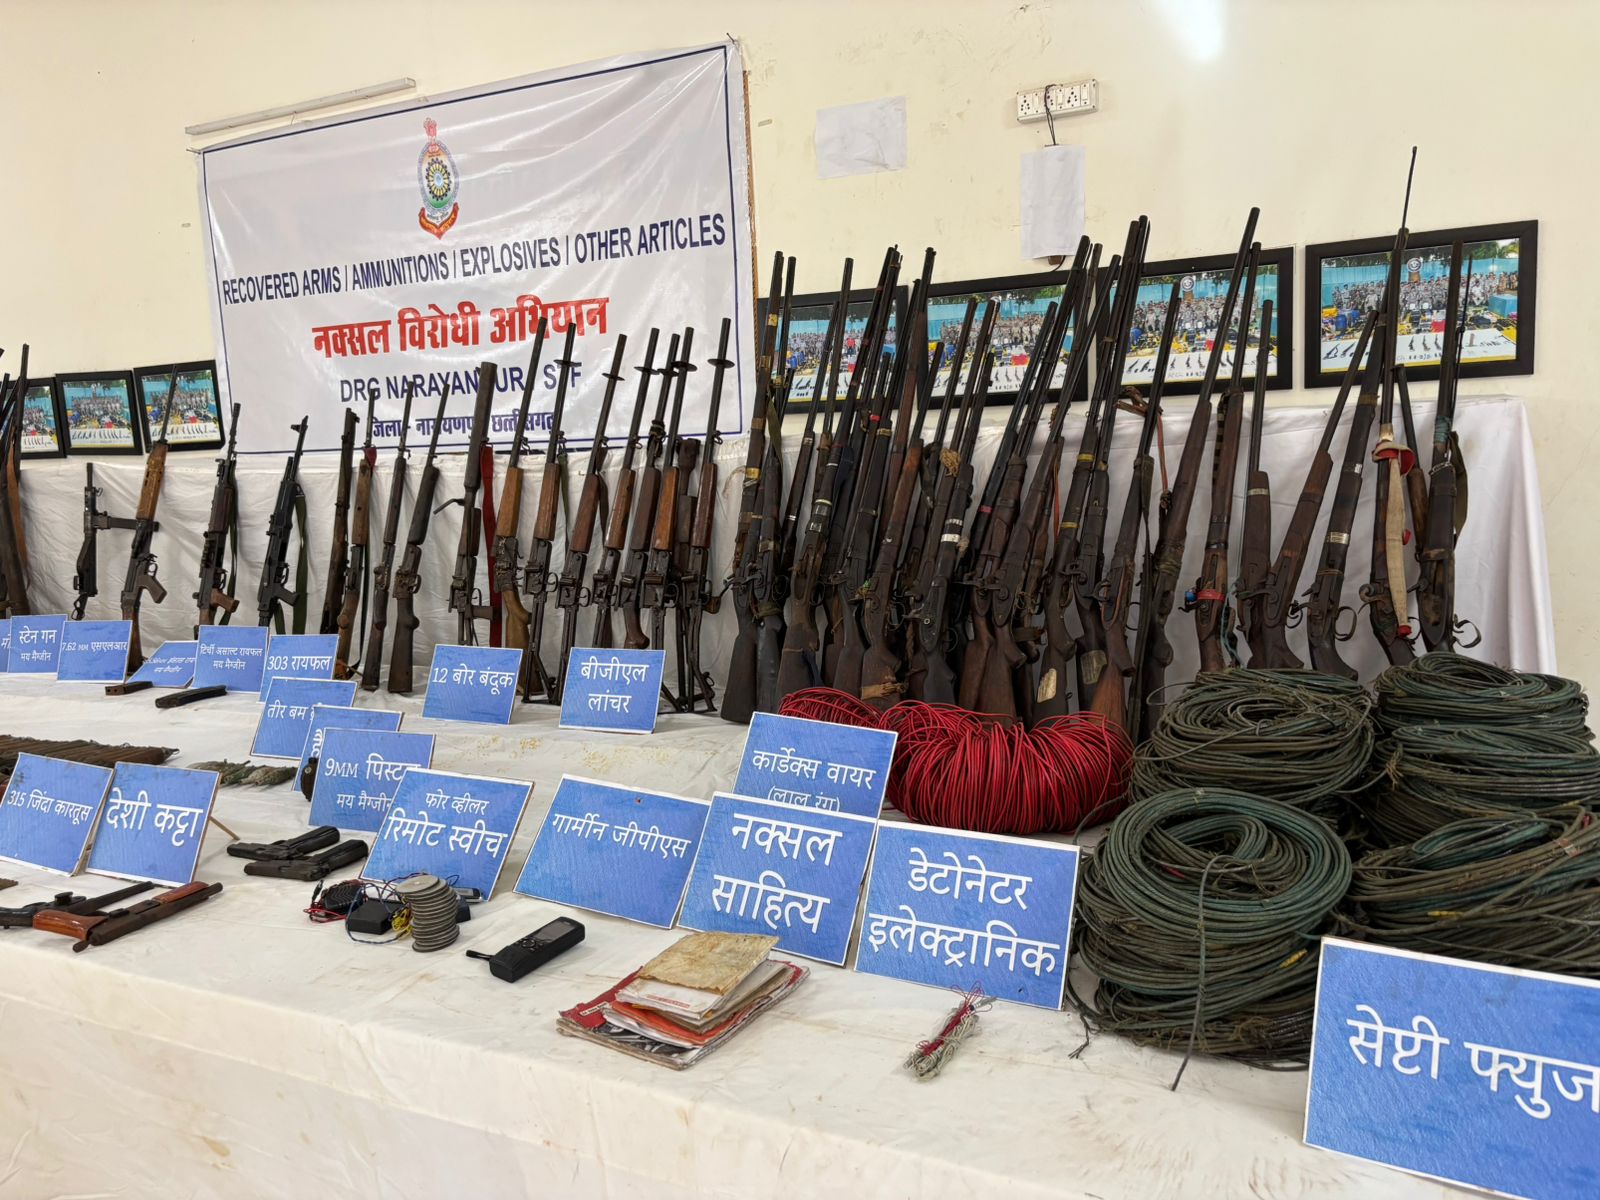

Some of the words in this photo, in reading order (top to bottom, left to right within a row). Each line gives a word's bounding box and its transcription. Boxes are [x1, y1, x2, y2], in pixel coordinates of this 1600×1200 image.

[222, 265, 300, 305] RECOVERED
[302, 266, 342, 297] ARMS
[351, 252, 451, 291] AMMUNITIONS
[461, 237, 561, 277] EXPLOSIVES
[574, 227, 632, 263] OTHER
[637, 213, 726, 255] ARTICLES
[311, 319, 392, 358] नक्सल
[398, 300, 481, 352] विरोधी
[489, 294, 609, 343] अभियान
[340, 377, 381, 403] DRG
[386, 367, 525, 400] NARAYANUR
[543, 362, 582, 390] SF
[19, 625, 39, 644] स्टेन
[41, 629, 57, 644] गन
[62, 642, 77, 651] 7.62
[91, 641, 128, 653] एसएलआर
[239, 647, 263, 658] रायफल
[267, 655, 288, 671] 303
[291, 655, 331, 672] रायफल
[432, 667, 448, 685] 12
[452, 663, 475, 688] बोर
[478, 665, 515, 695] बंदूक
[580, 656, 649, 684] बीजीएल
[267, 699, 287, 720] तीर
[289, 705, 308, 721] बम
[588, 690, 632, 714] लांचर
[324, 758, 358, 778] 9MM
[365, 753, 422, 782] पिस्ट
[752, 747, 822, 779] कार्डेक्स
[827, 762, 876, 790] वायर
[7, 789, 26, 807] 315
[28, 788, 53, 814] जिंदा
[54, 798, 93, 825] कारतूस
[106, 787, 151, 831] देशी
[154, 803, 203, 847] कट्टा
[337, 793, 356, 809] मय
[425, 788, 450, 810] फोर
[451, 792, 489, 815] व्हीलर
[384, 807, 446, 846] रिमोट
[449, 819, 508, 858] स्वीच
[612, 820, 691, 859] जीपीएस
[731, 812, 842, 866] नक्सल
[907, 847, 1033, 910] डेटोनेटर
[712, 869, 830, 934] साहित्य
[868, 904, 1061, 977] इलेक्ट्रानिक
[1463, 1042, 1600, 1120] फ्युज
